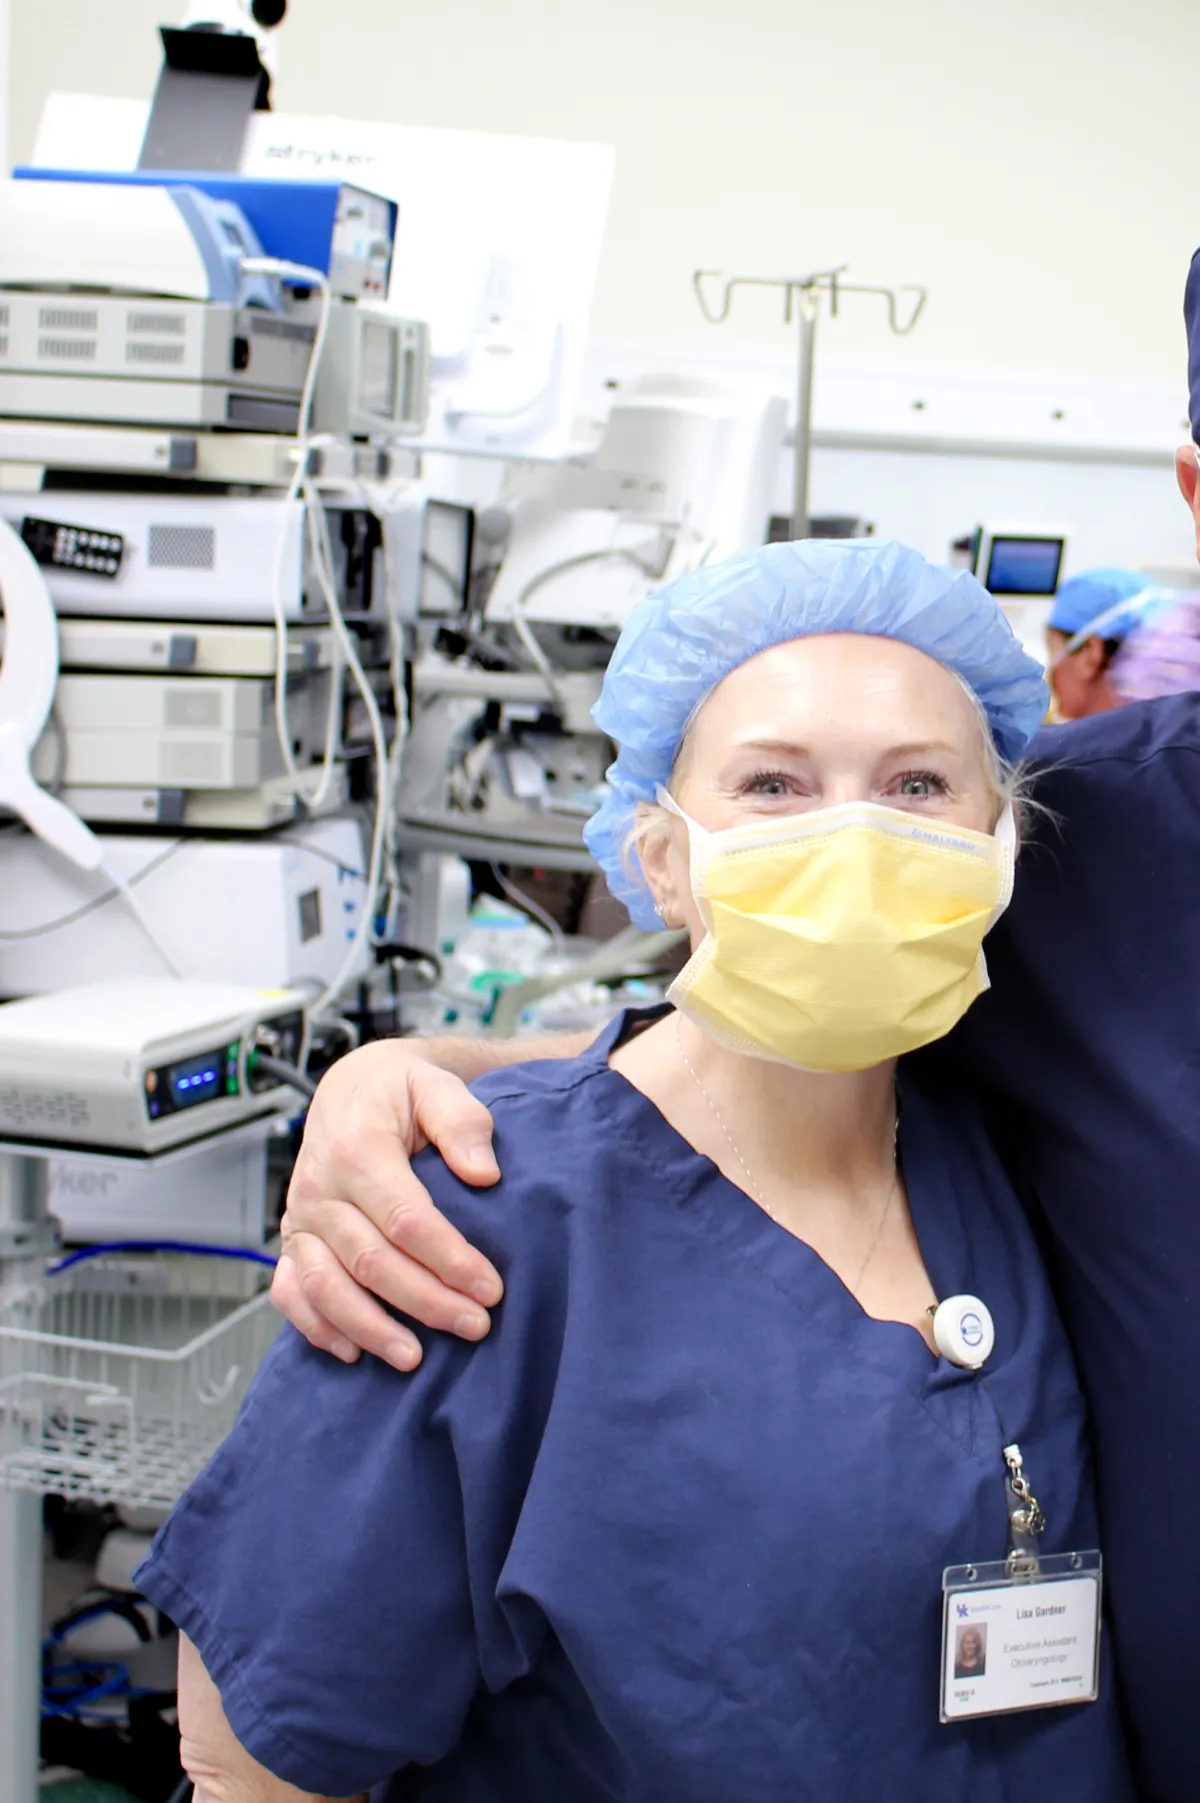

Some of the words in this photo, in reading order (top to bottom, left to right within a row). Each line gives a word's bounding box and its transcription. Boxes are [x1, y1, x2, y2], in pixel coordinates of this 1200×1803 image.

[1016, 1608, 1033, 1620] Lisa
[1035, 1605, 1067, 1617] Gardner
[1003, 1641, 1041, 1654] Executive
